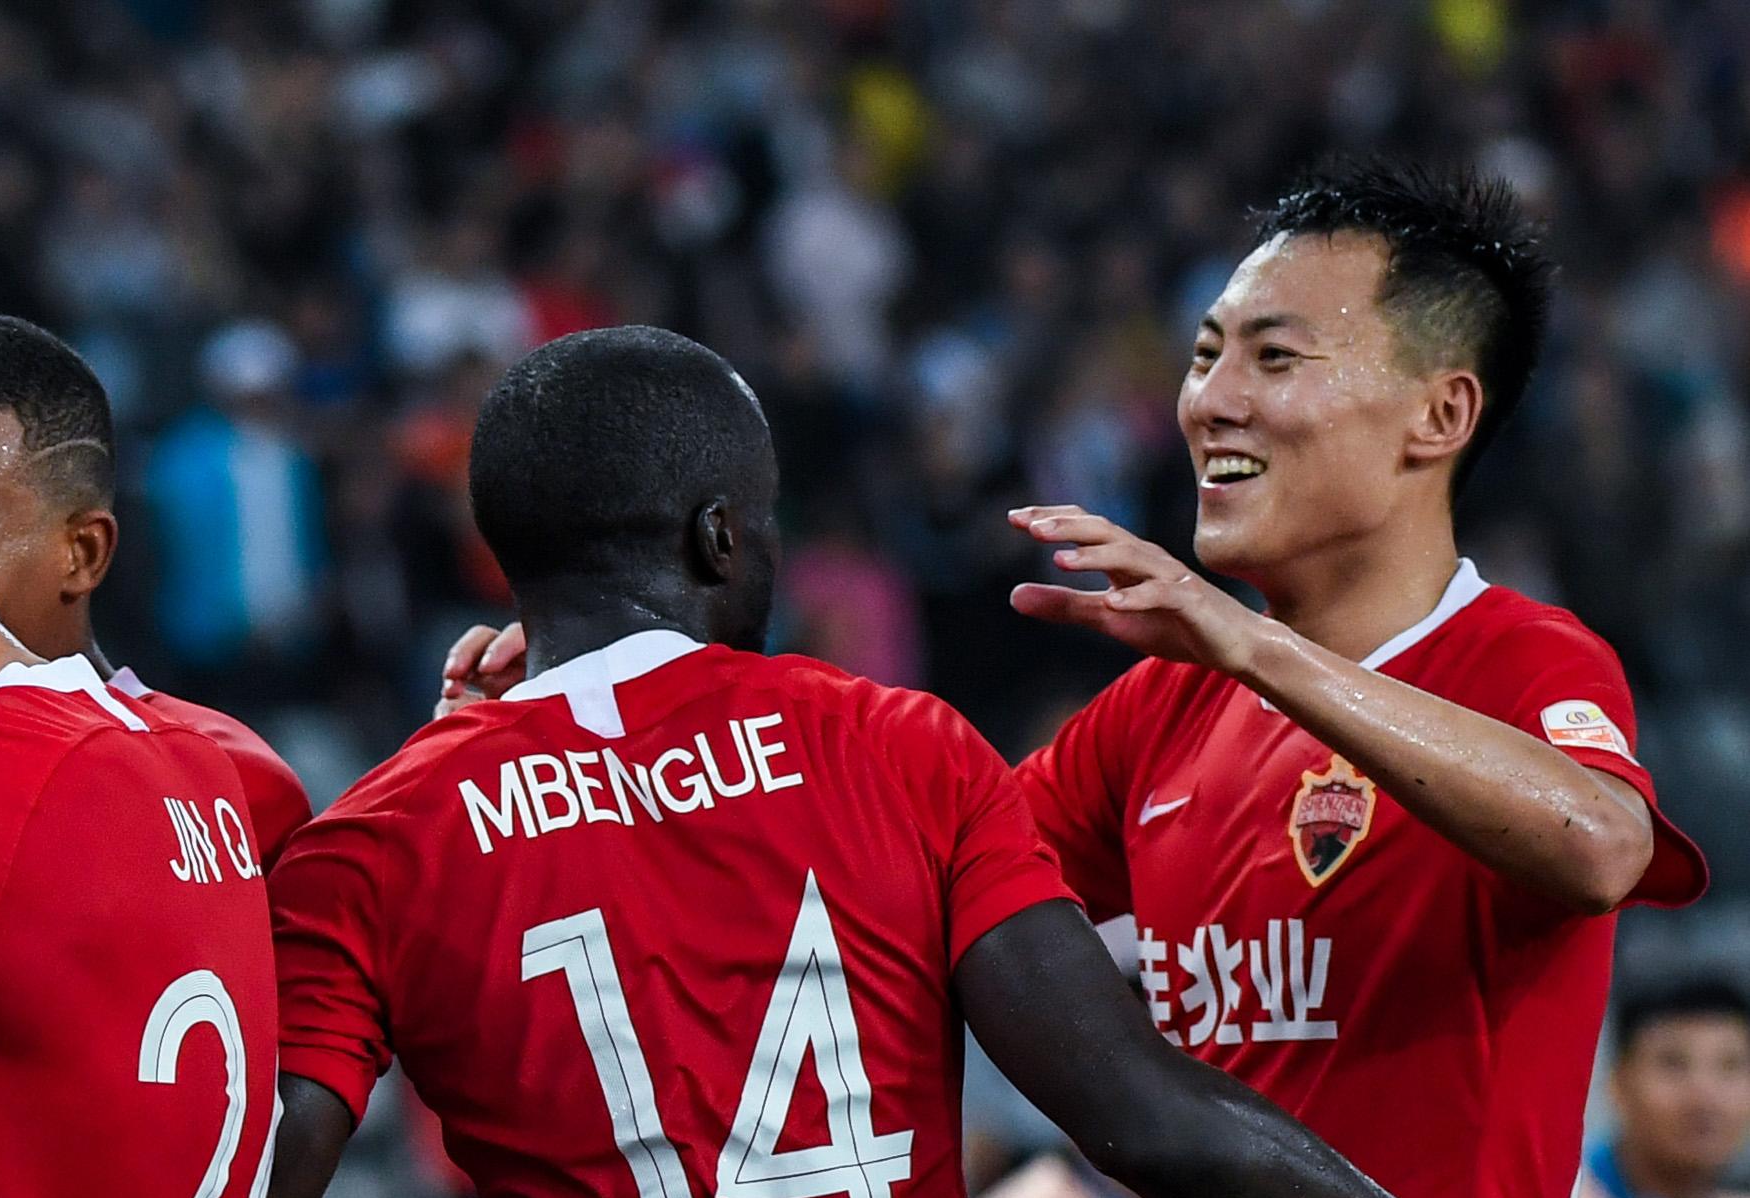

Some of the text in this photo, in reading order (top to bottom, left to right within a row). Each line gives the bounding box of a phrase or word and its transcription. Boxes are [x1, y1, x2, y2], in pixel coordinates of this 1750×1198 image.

[458, 712, 803, 854] MBENGUE
[163, 797, 262, 884] JIN Q.
